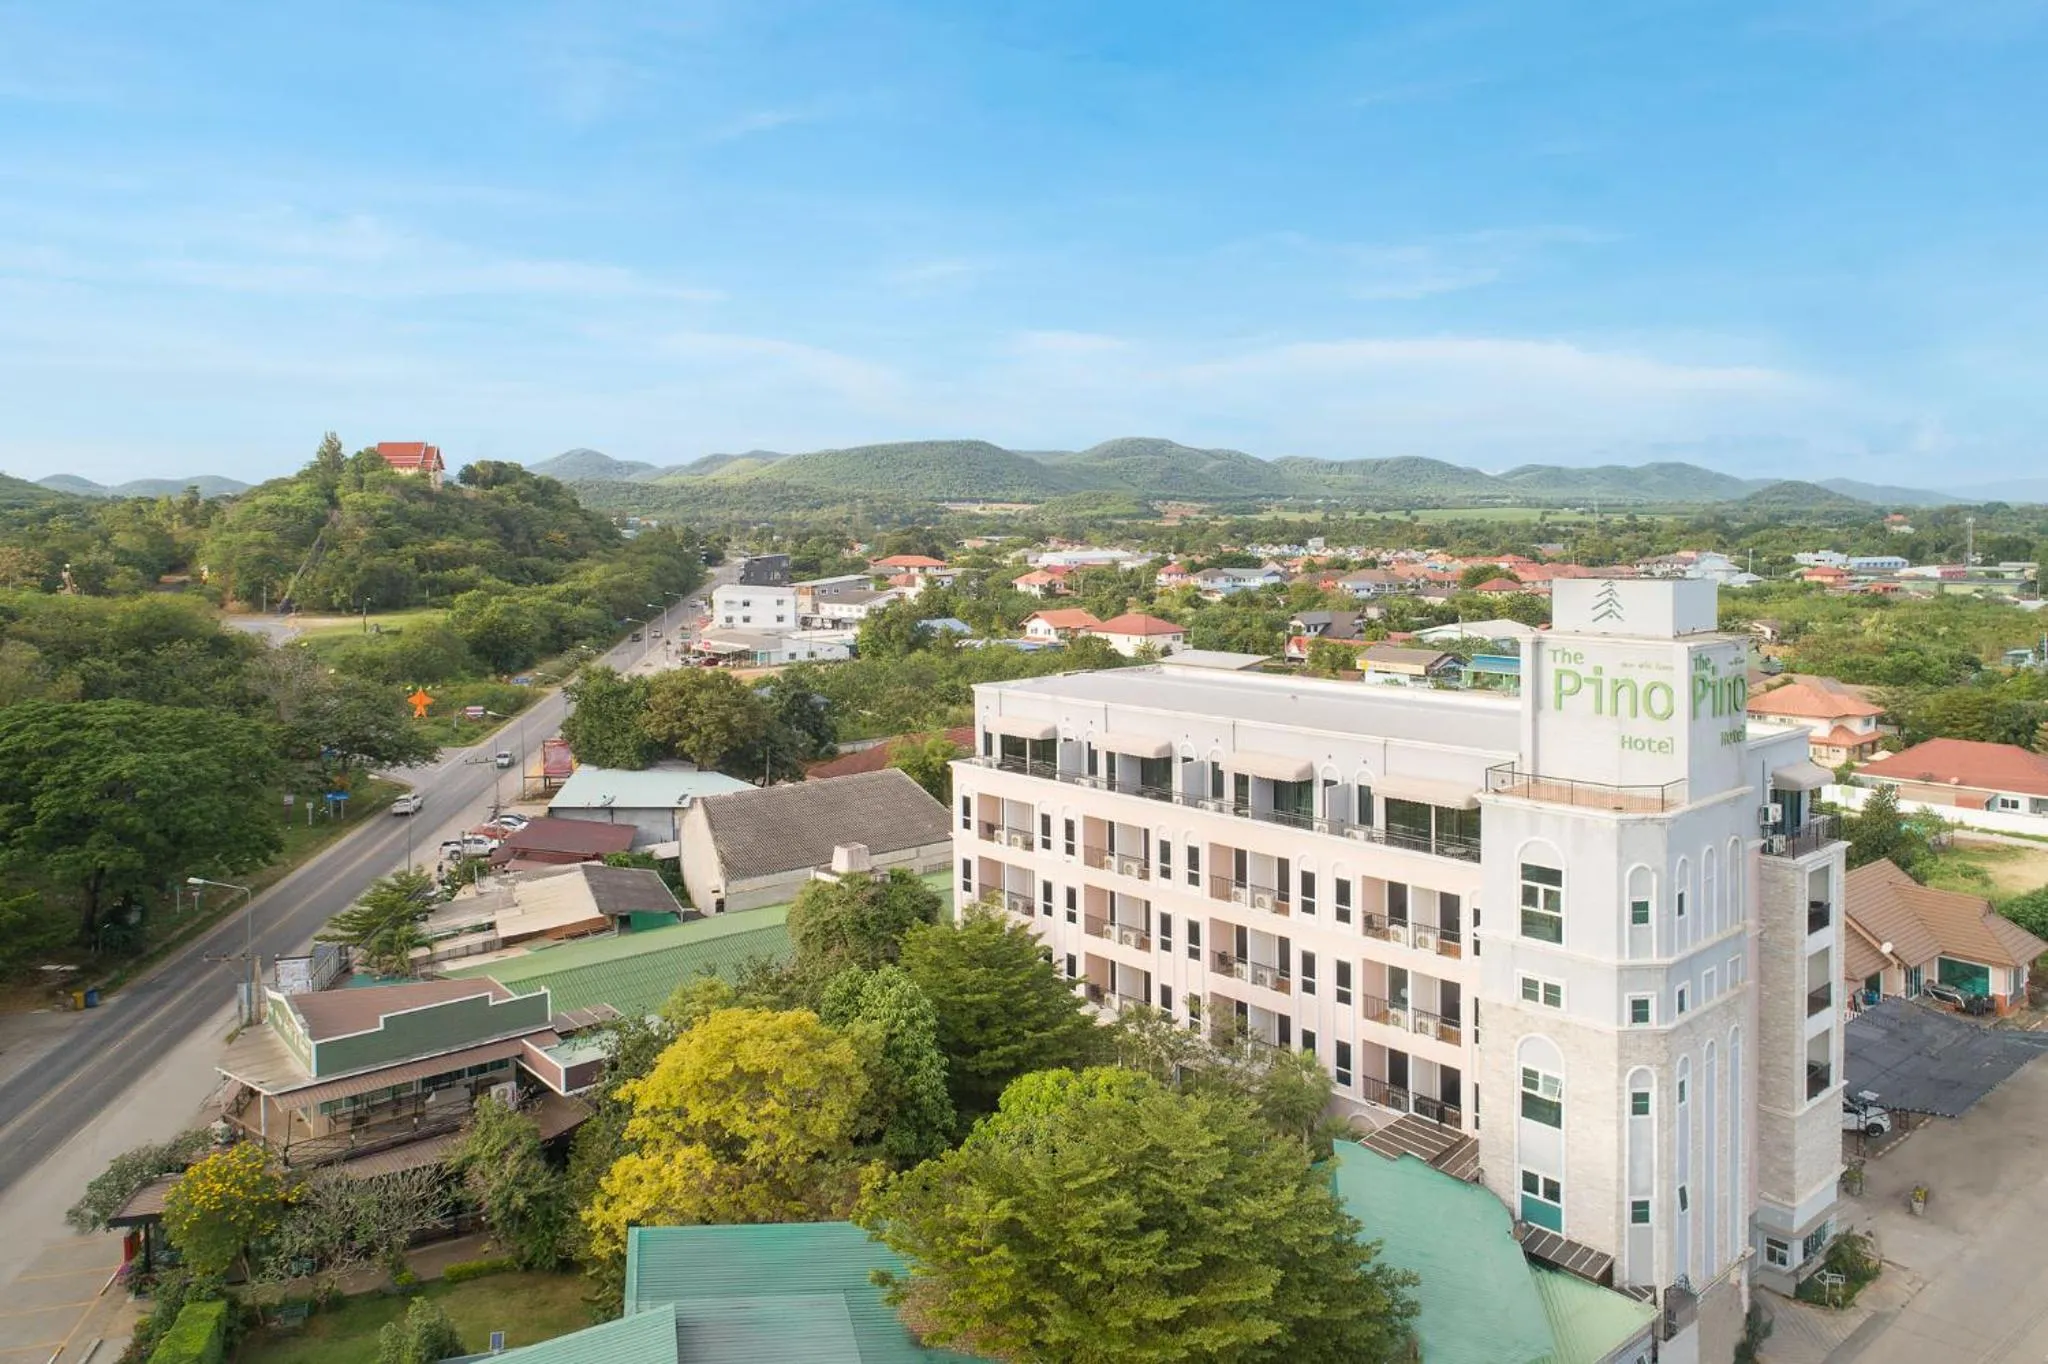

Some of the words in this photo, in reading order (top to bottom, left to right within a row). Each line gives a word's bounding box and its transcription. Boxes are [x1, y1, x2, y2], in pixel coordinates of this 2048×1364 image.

[1549, 648, 1584, 665] The
[1553, 665, 1675, 721] Pino
[1692, 664, 1746, 720] Pino
[1621, 735, 1674, 755] Hotel
